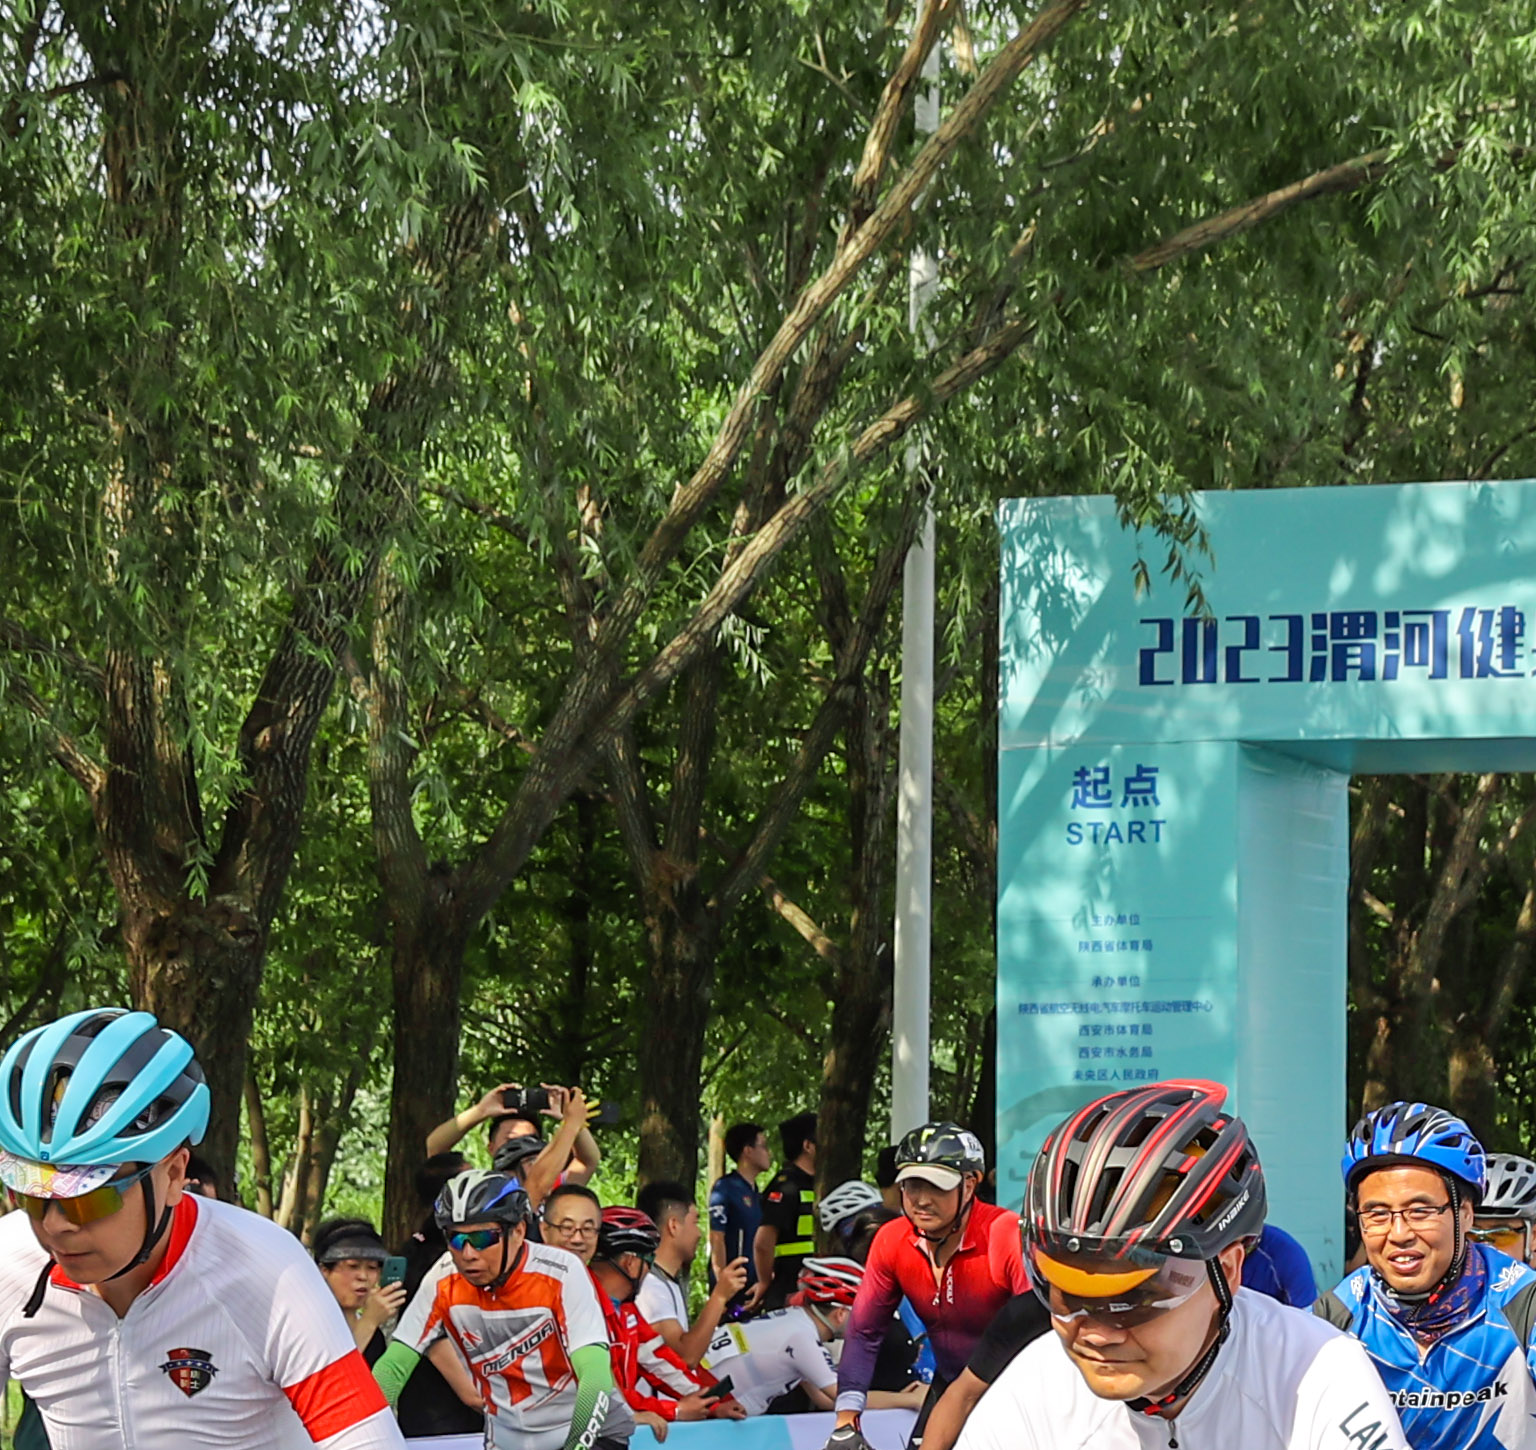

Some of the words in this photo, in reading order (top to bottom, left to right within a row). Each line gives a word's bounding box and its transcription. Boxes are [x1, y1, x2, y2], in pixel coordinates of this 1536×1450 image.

[1070, 764, 1160, 809] 起点
[1066, 820, 1166, 845] START
[1091, 914, 1141, 927] 主办单位
[1077, 940, 1153, 953] 陕西省体育局
[1090, 976, 1141, 988] 承办单位
[1078, 1024, 1153, 1037] 西安市体育局
[1078, 1046, 1153, 1059] 西安市水务局
[1072, 1069, 1159, 1081] 未央区人民政府
[482, 1321, 555, 1377] MERIDA
